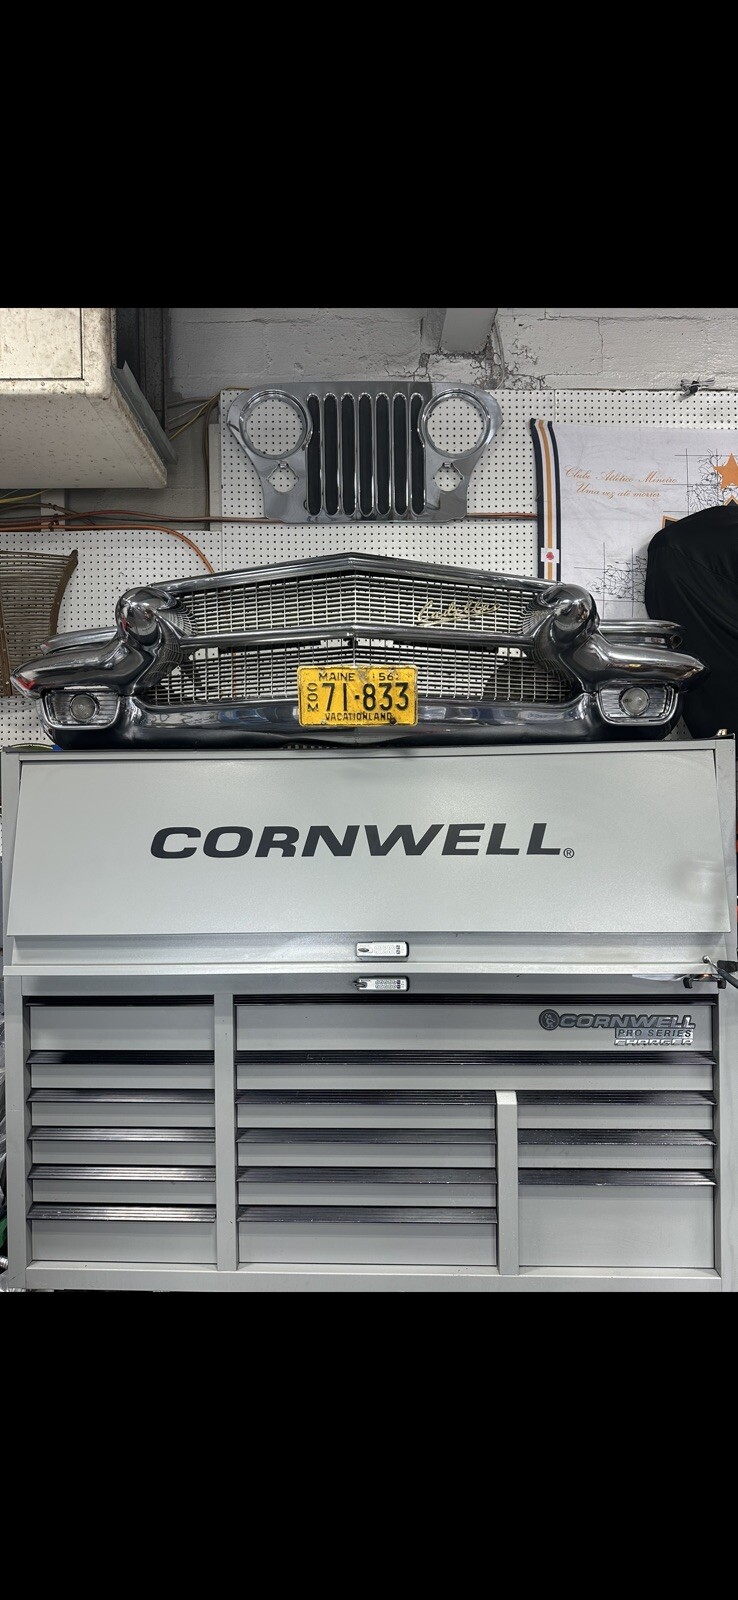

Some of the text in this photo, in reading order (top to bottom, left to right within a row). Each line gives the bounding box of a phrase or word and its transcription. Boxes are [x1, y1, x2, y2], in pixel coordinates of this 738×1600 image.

[565, 465, 591, 480] Clube
[638, 471, 678, 484] Mineiro
[576, 481, 600, 495] Uma
[602, 491, 615, 500] vez
[617, 490, 631, 498] até
[319, 672, 356, 681] MAINE
[306, 682, 319, 712] COM
[325, 712, 393, 721] VACATIONLAND
[559, 1013, 696, 1029] CORNWELL
[617, 1029, 692, 1037] PRO SERIES
